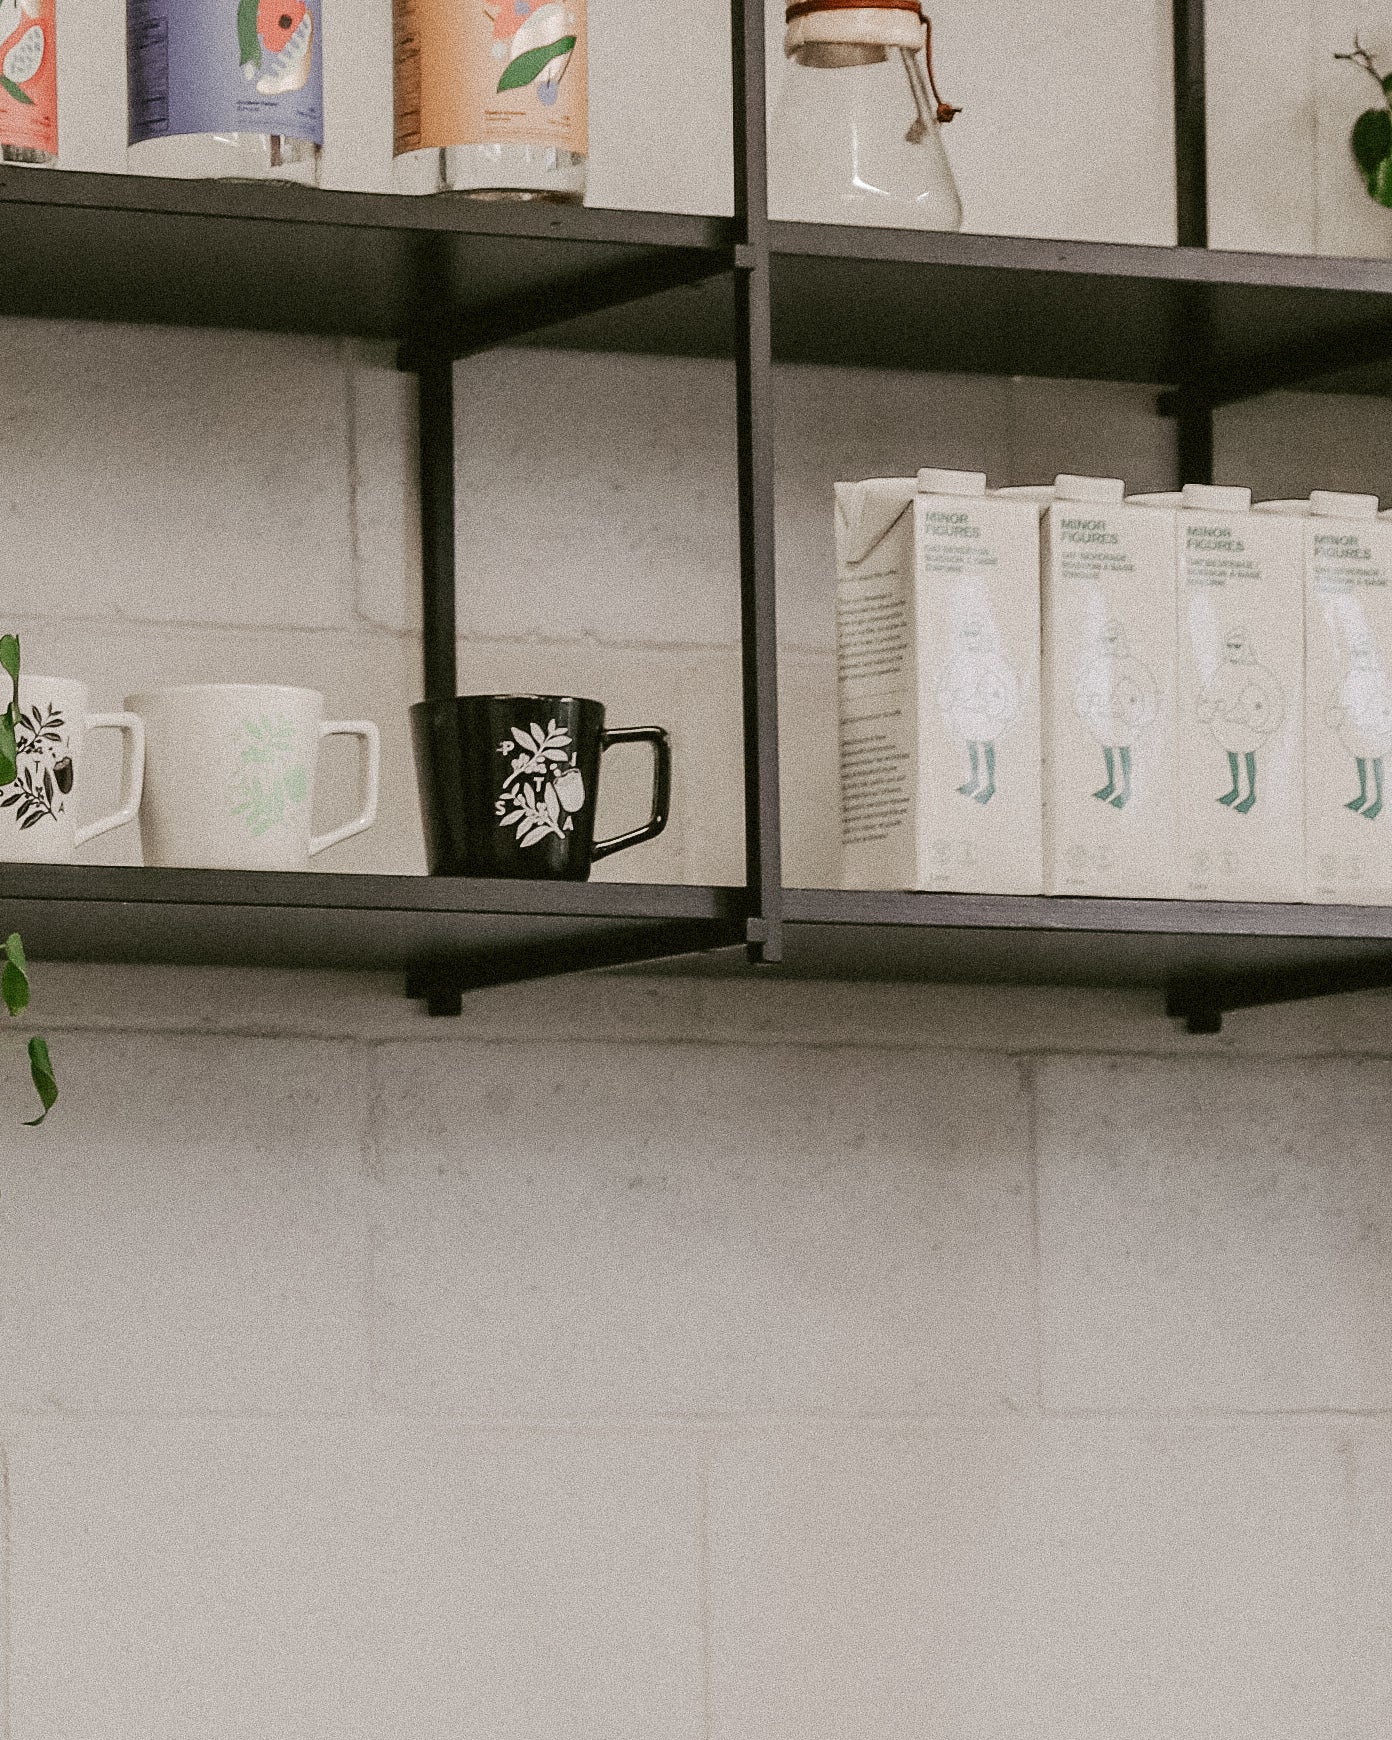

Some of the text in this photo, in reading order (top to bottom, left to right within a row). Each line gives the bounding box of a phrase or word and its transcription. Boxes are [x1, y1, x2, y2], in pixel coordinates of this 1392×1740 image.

[925, 512, 968, 524] MINOR
[1060, 518, 1106, 531] MINOR
[925, 525, 980, 538] FIGURES
[1061, 532, 1119, 544] FIGURES
[1187, 526, 1232, 538] MINOR
[1187, 538, 1245, 552] FIGURES
[1314, 535, 1359, 546] MINOR
[1314, 547, 1372, 560] FIGURES
[494, 800, 506, 816] S
[562, 815, 574, 831] A
